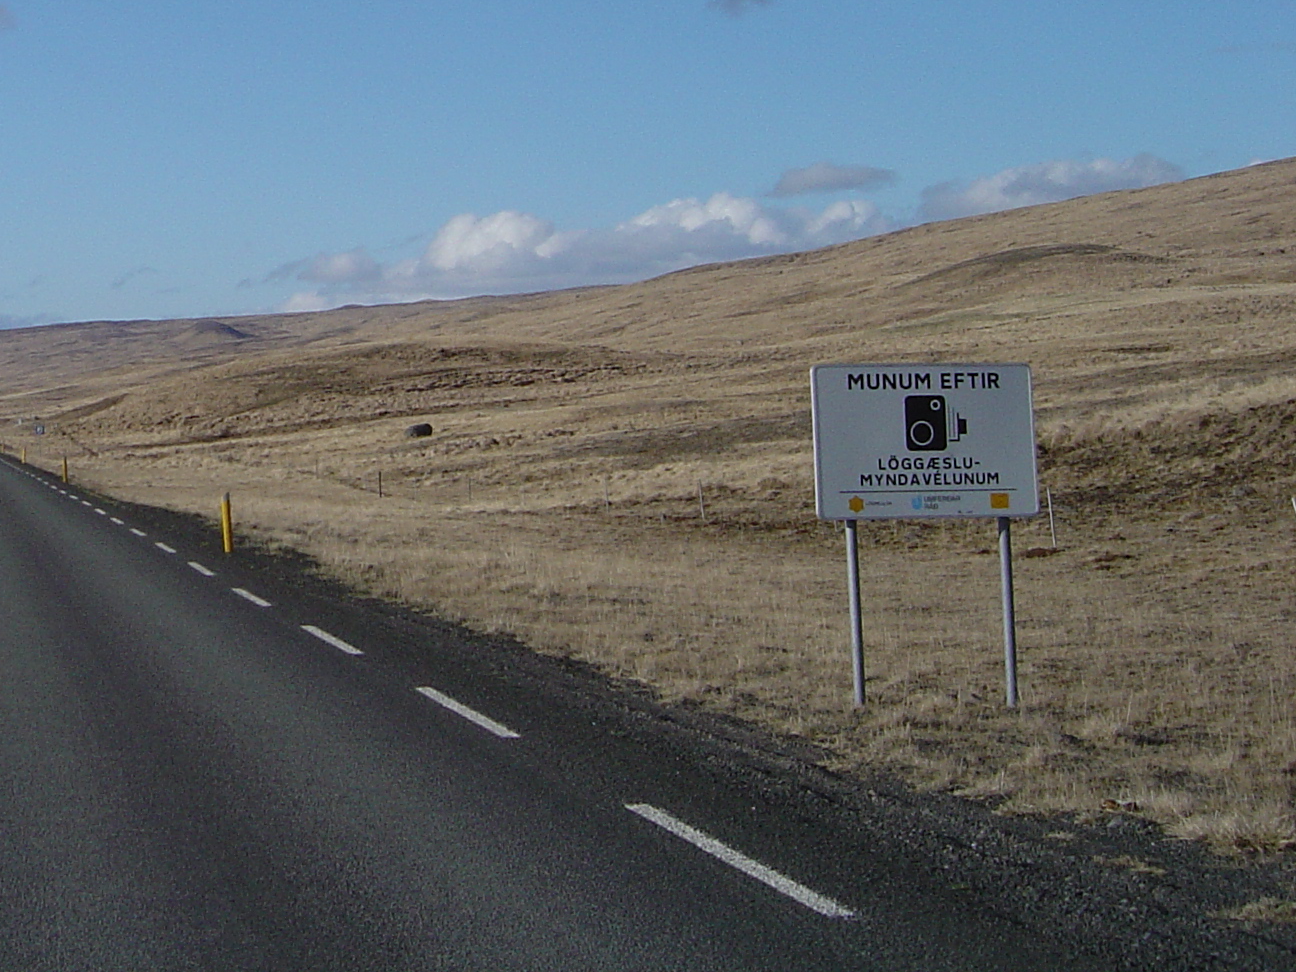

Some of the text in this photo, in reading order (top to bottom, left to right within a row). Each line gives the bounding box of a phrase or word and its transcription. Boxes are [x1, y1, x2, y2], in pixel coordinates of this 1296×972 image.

[847, 372, 1000, 390] MUNUM EFTIR
[878, 455, 981, 471] LÖGGÆSLU-
[860, 470, 1000, 486] MYNDAVÉLUNUM
